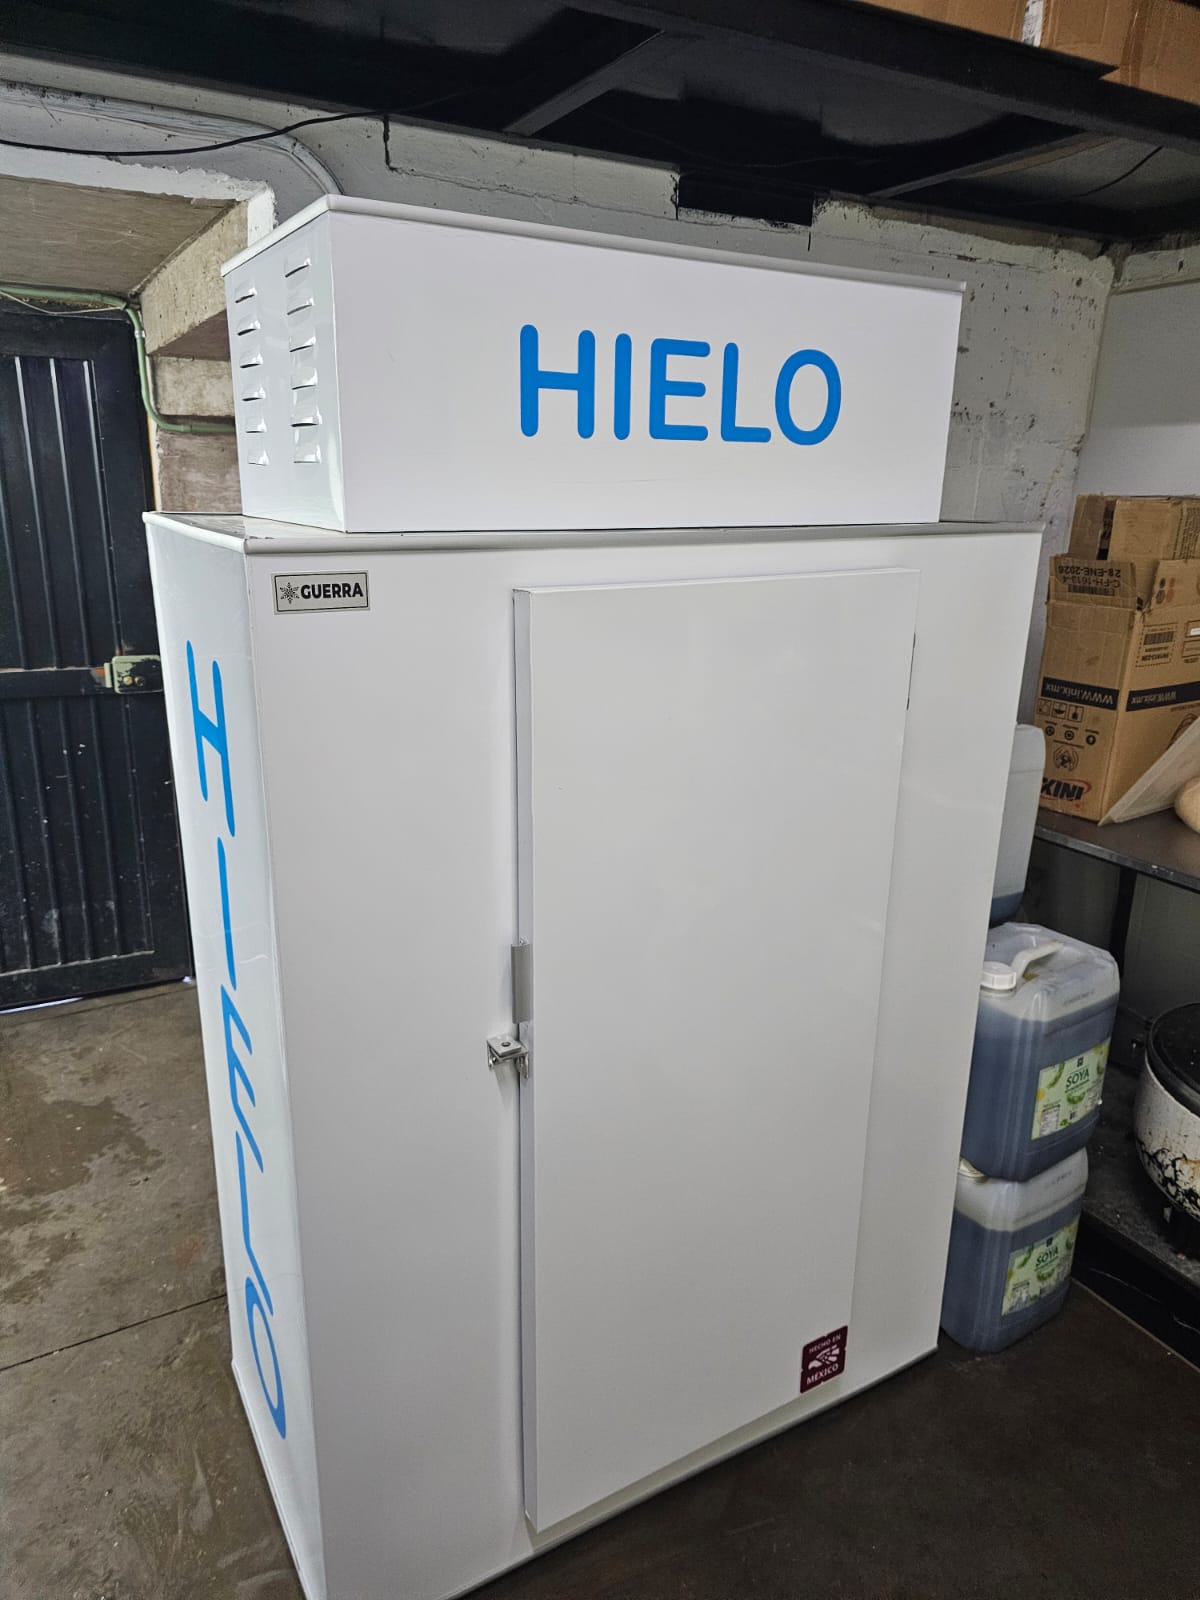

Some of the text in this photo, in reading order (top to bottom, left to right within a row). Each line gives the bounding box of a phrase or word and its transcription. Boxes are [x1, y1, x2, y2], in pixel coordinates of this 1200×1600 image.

[520, 325, 841, 446] HIELO
[300, 582, 364, 599] GUERRA
[1041, 777, 1085, 800] INIX
[185, 639, 286, 1440] HIELO
[1066, 1068, 1090, 1088] SOYA
[1035, 1246, 1059, 1266] SOYA
[808, 1334, 842, 1354] HECHO EN
